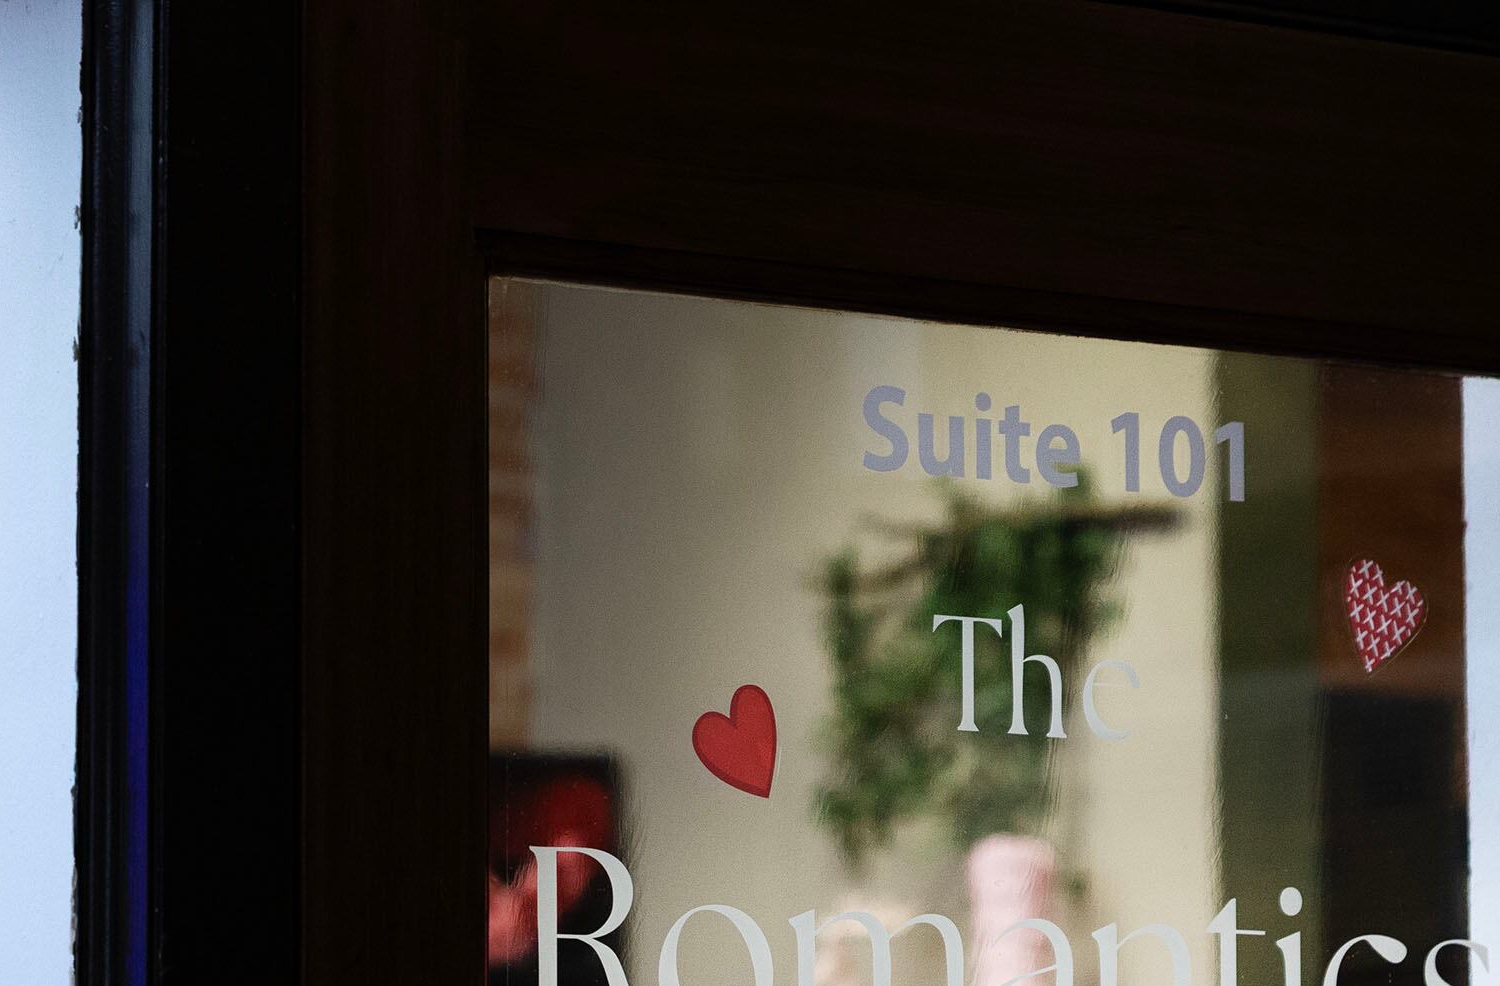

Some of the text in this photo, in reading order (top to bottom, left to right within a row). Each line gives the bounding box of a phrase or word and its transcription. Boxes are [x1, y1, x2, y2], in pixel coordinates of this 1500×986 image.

[863, 385, 1247, 503] Suite 101
[932, 603, 1141, 742] The
